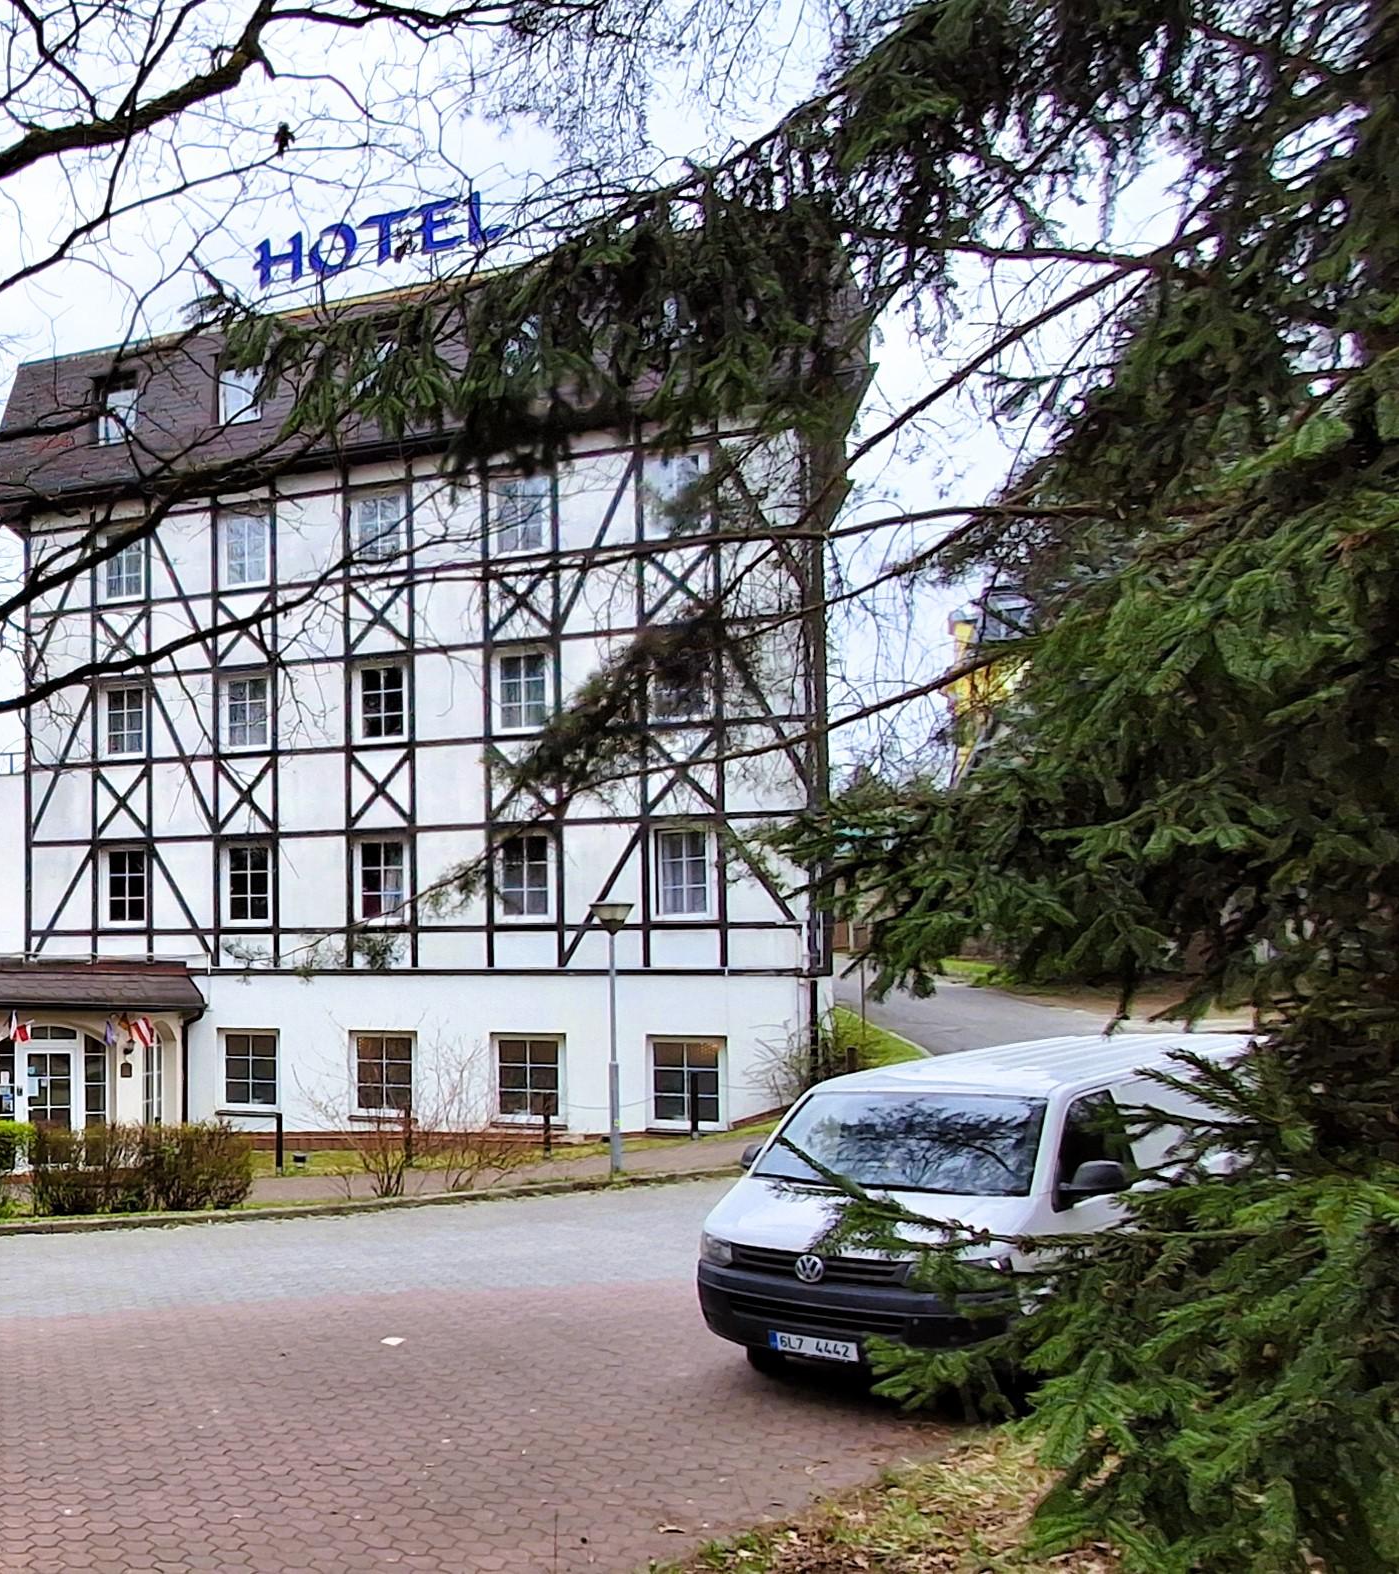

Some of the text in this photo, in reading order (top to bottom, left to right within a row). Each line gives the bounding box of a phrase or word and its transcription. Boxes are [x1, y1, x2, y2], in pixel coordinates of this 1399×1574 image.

[254, 191, 507, 289] HOTEL
[779, 1336, 850, 1358] 6L7 4442
